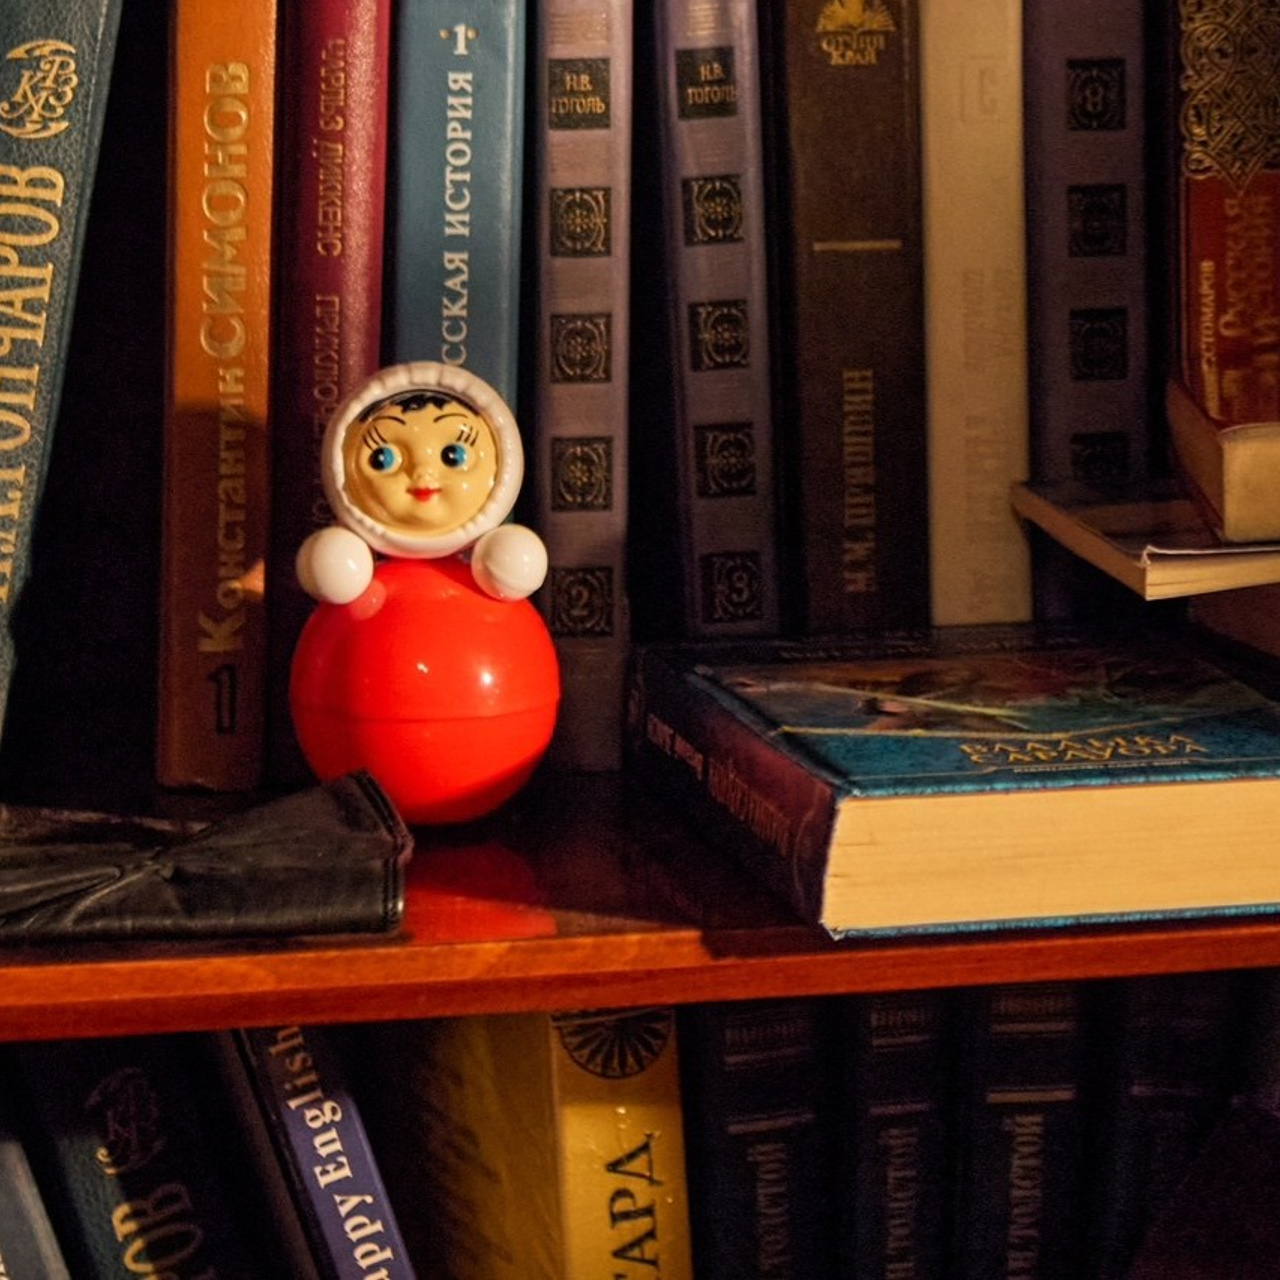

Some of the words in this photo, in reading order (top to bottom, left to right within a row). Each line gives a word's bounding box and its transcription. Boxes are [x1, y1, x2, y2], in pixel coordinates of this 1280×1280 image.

[318, 38, 348, 133] ЧАРЛЬЗ
[451, 23, 469, 56] 1
[687, 84, 738, 105] ГОГОЛЬ
[443, 70, 475, 238] ИСТОРИЯ
[551, 95, 607, 115] ГОГОЛЬ
[200, 61, 252, 358] СИМОНОВ
[312, 138, 348, 259] ДИККЕНС
[313, 295, 341, 422] ПРИКЛЮ
[441, 251, 470, 367] ССКАЯ
[199, 363, 247, 656] Константин
[269, 1024, 356, 1189] English
[606, 1128, 665, 1280] АРД
